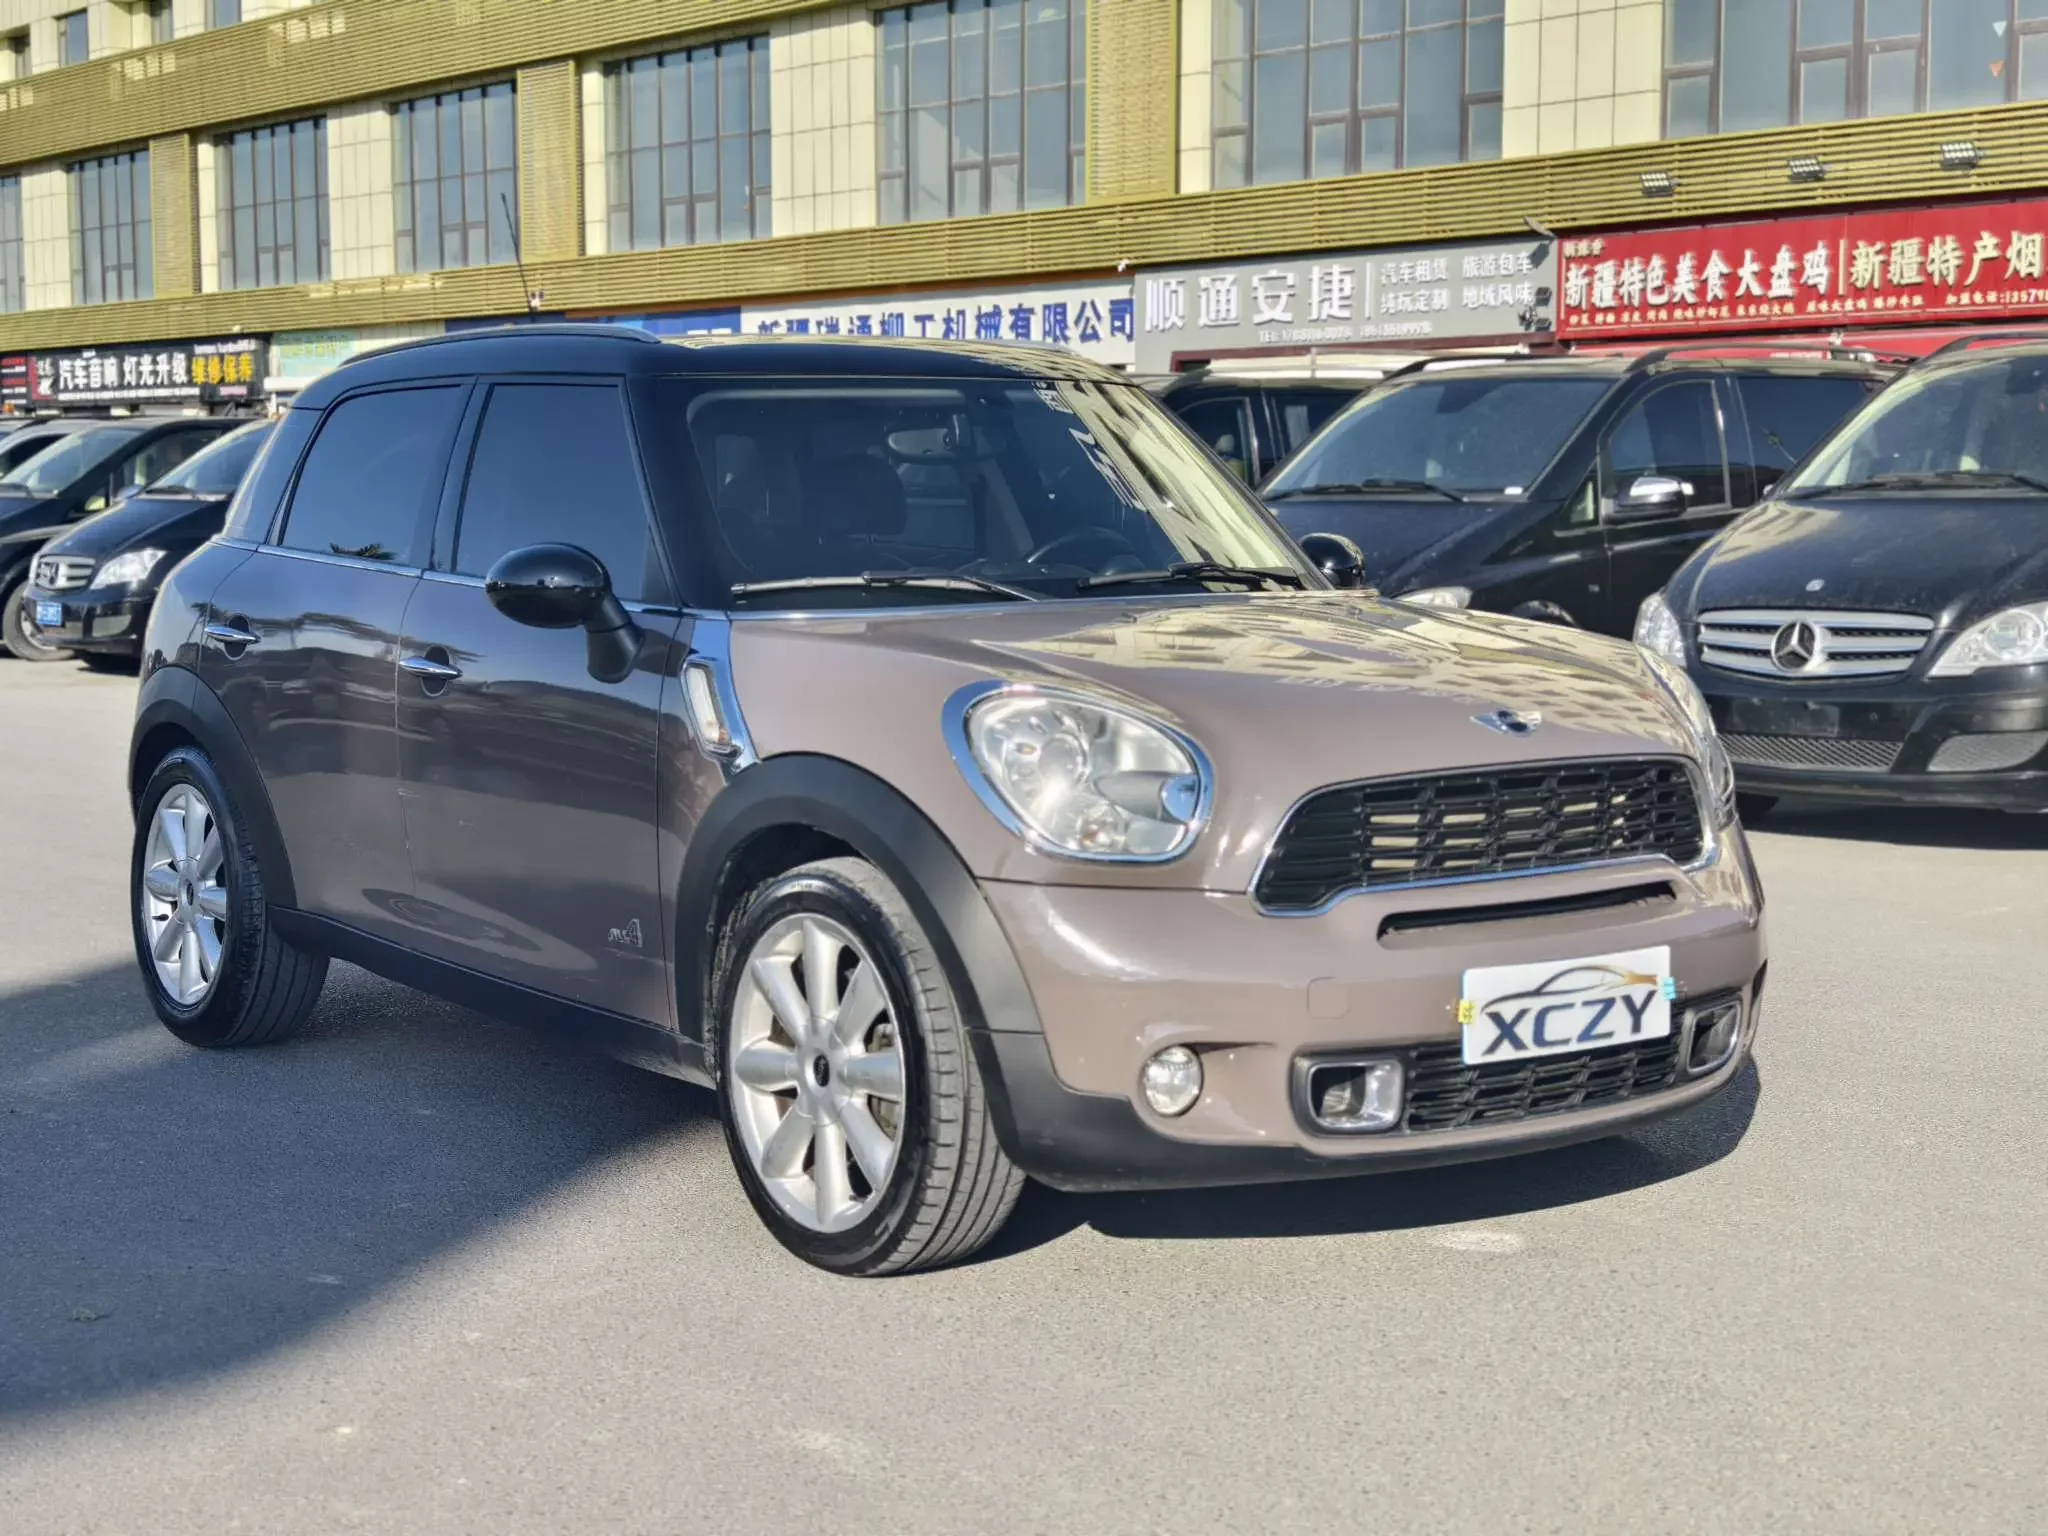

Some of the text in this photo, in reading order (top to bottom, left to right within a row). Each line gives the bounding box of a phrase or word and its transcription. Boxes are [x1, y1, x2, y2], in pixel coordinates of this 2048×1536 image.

[1145, 263, 1356, 333] 顺通安捷
[1462, 251, 1534, 278] 旅游包车
[1565, 230, 2045, 310] 新疆特色美食大盘鸡 新疆特产烟
[58, 357, 119, 390] 汽车音响
[1480, 989, 1657, 1057] XCZY
